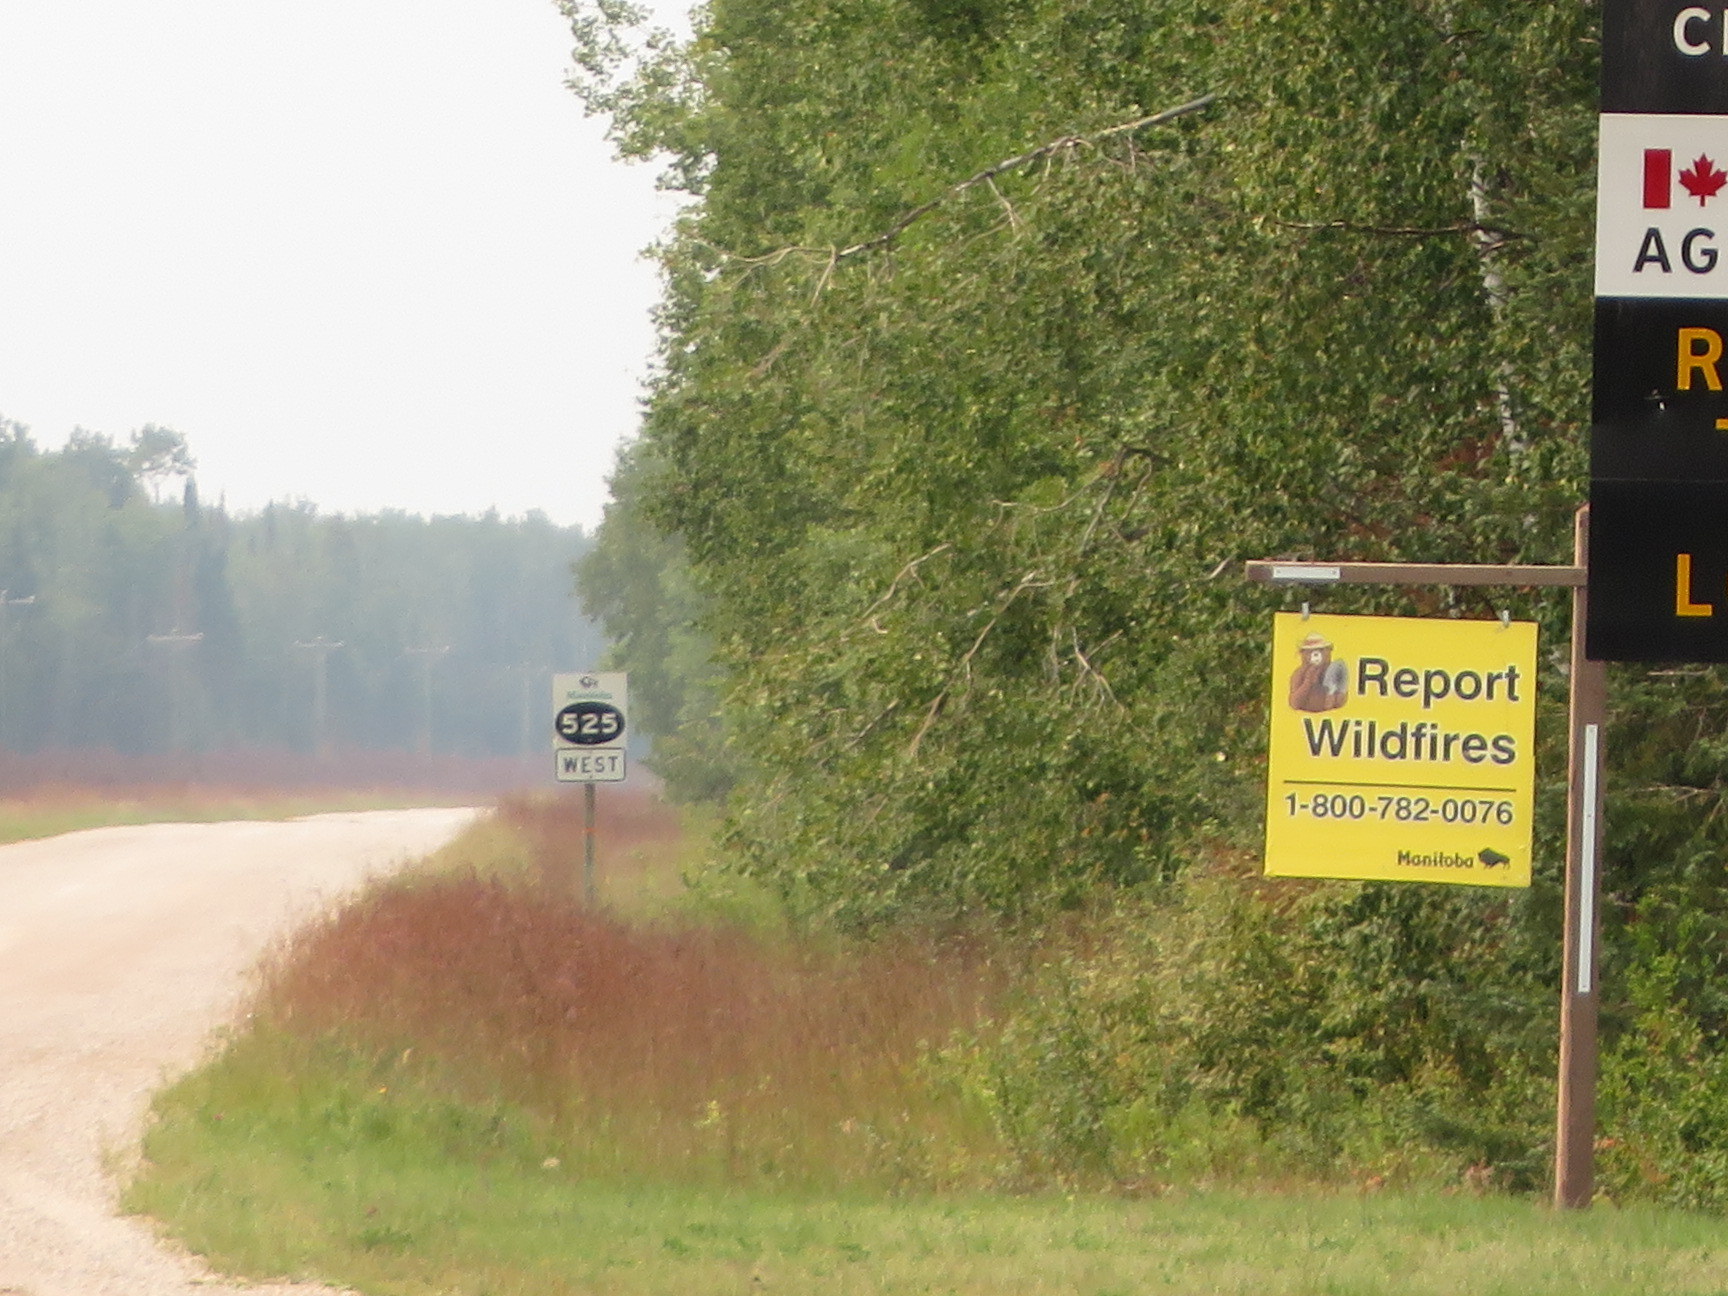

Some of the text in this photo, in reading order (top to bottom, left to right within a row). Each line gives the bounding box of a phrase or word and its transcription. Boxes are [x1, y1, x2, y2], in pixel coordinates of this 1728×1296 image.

[1358, 657, 1520, 708] Report
[561, 712, 619, 735] 525
[1304, 718, 1516, 765] Wildfires
[563, 755, 618, 774] WEST
[1285, 792, 1515, 826] 1-800-782-0076
[1397, 850, 1474, 869] Manitoba
